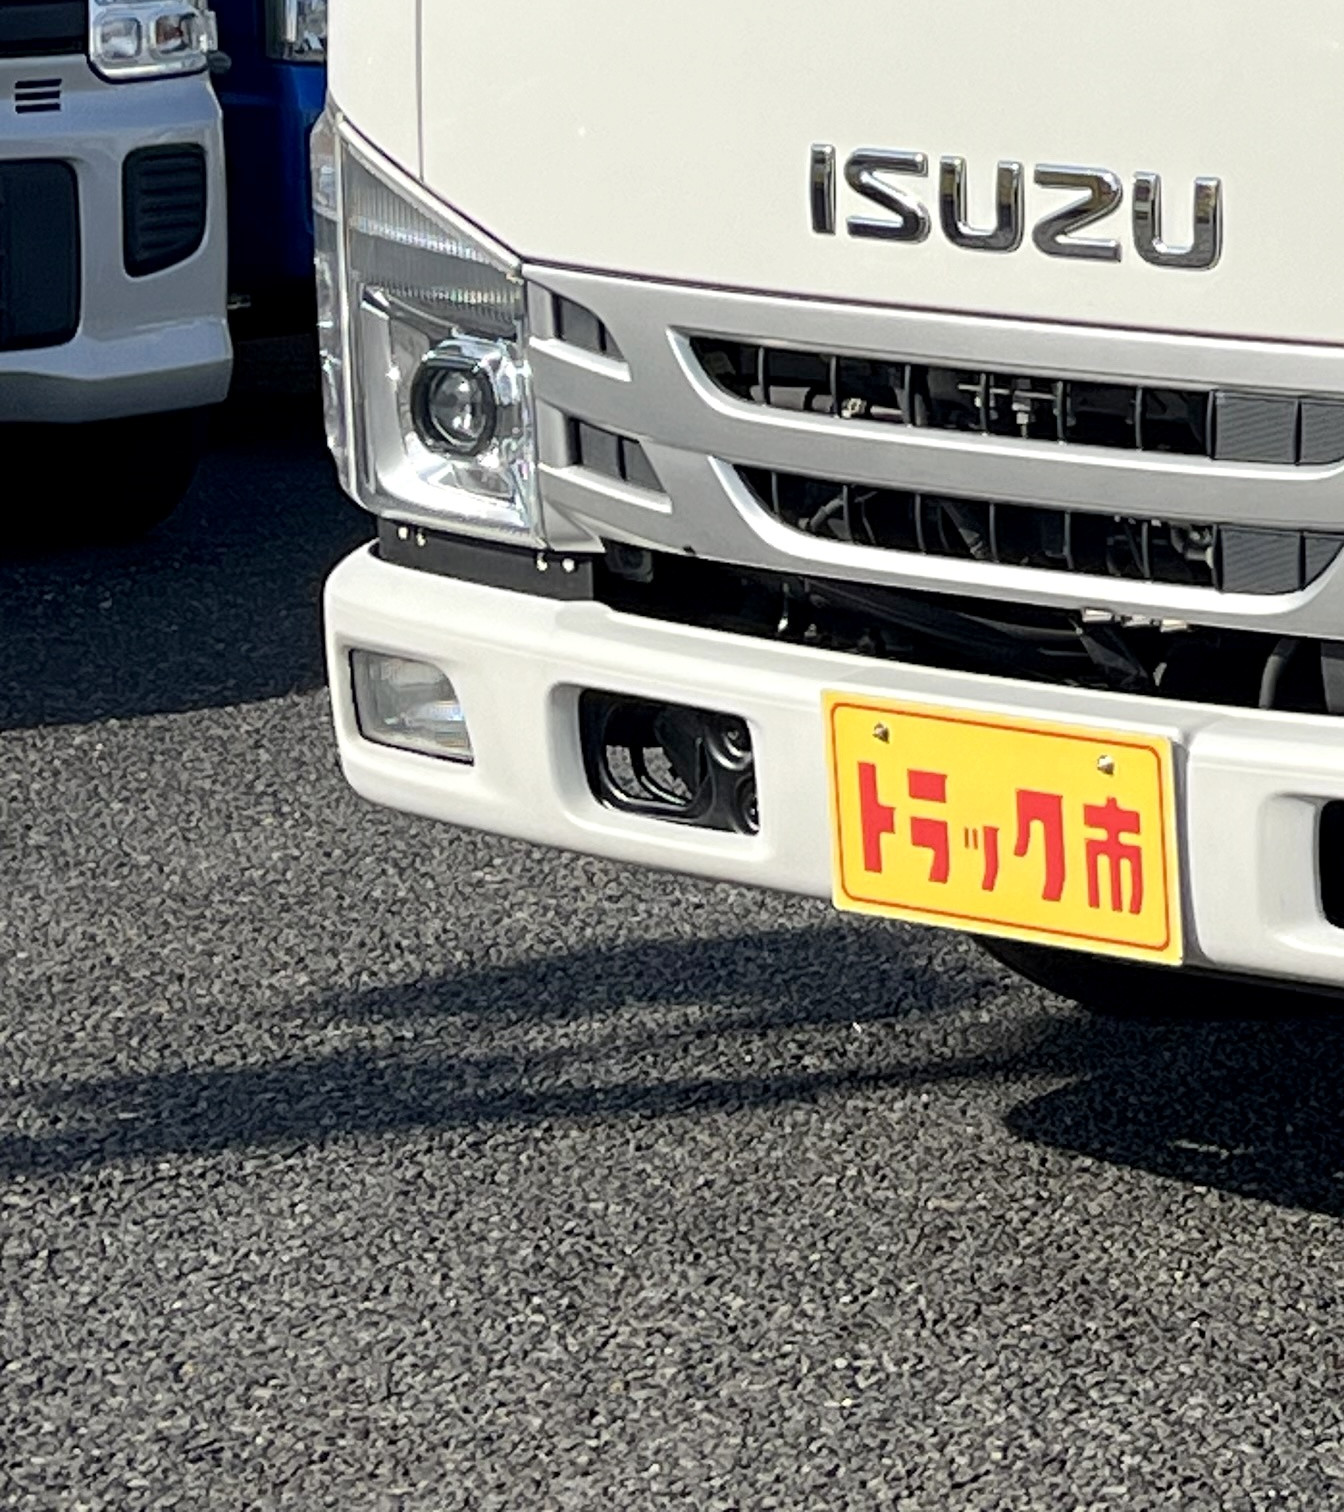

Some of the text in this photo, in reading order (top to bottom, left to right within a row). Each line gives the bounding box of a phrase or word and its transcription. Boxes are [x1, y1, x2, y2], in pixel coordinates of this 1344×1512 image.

[810, 142, 1223, 271] ISUZU
[857, 761, 1144, 916] トラック市
